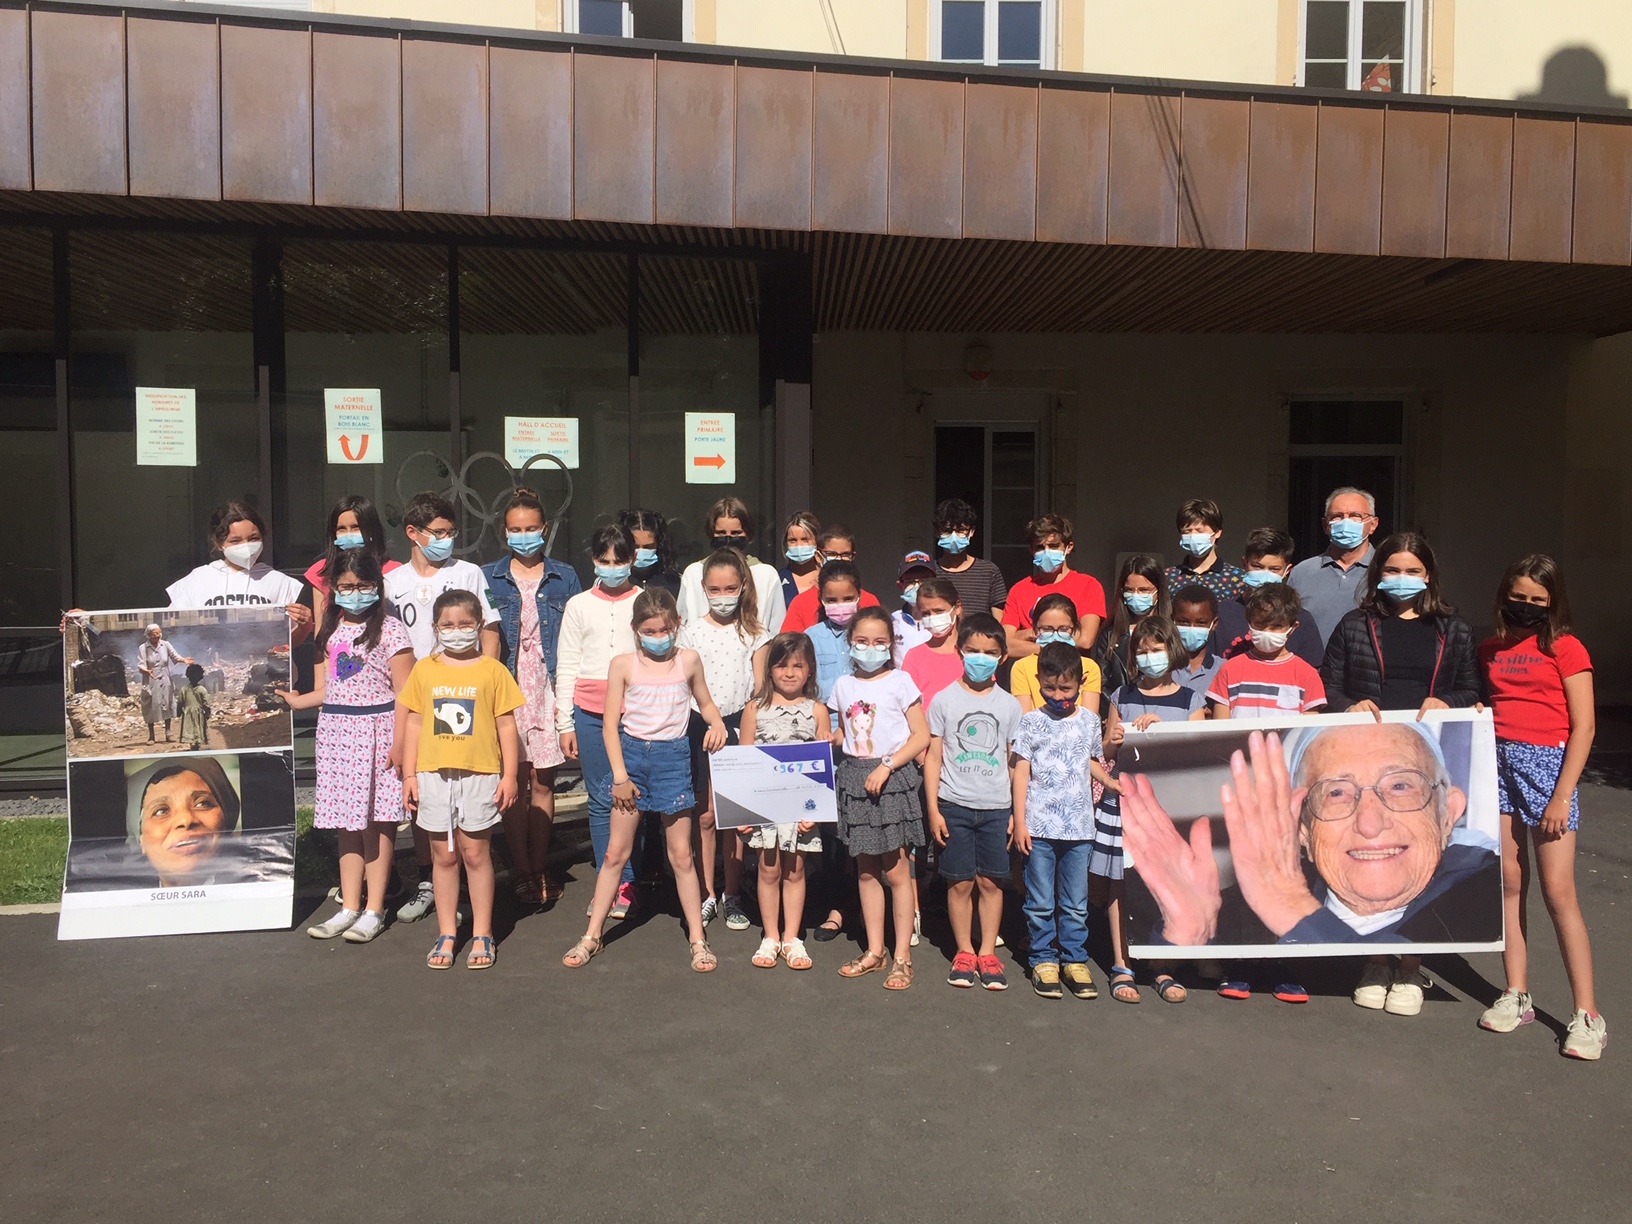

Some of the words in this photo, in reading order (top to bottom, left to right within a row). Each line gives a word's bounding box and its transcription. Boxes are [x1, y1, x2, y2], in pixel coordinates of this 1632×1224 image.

[395, 602, 416, 627] 10
[432, 686, 456, 697] NEW
[458, 686, 477, 697] LIFE
[151, 892, 179, 900] SŒUR
[181, 890, 206, 899] SARA
